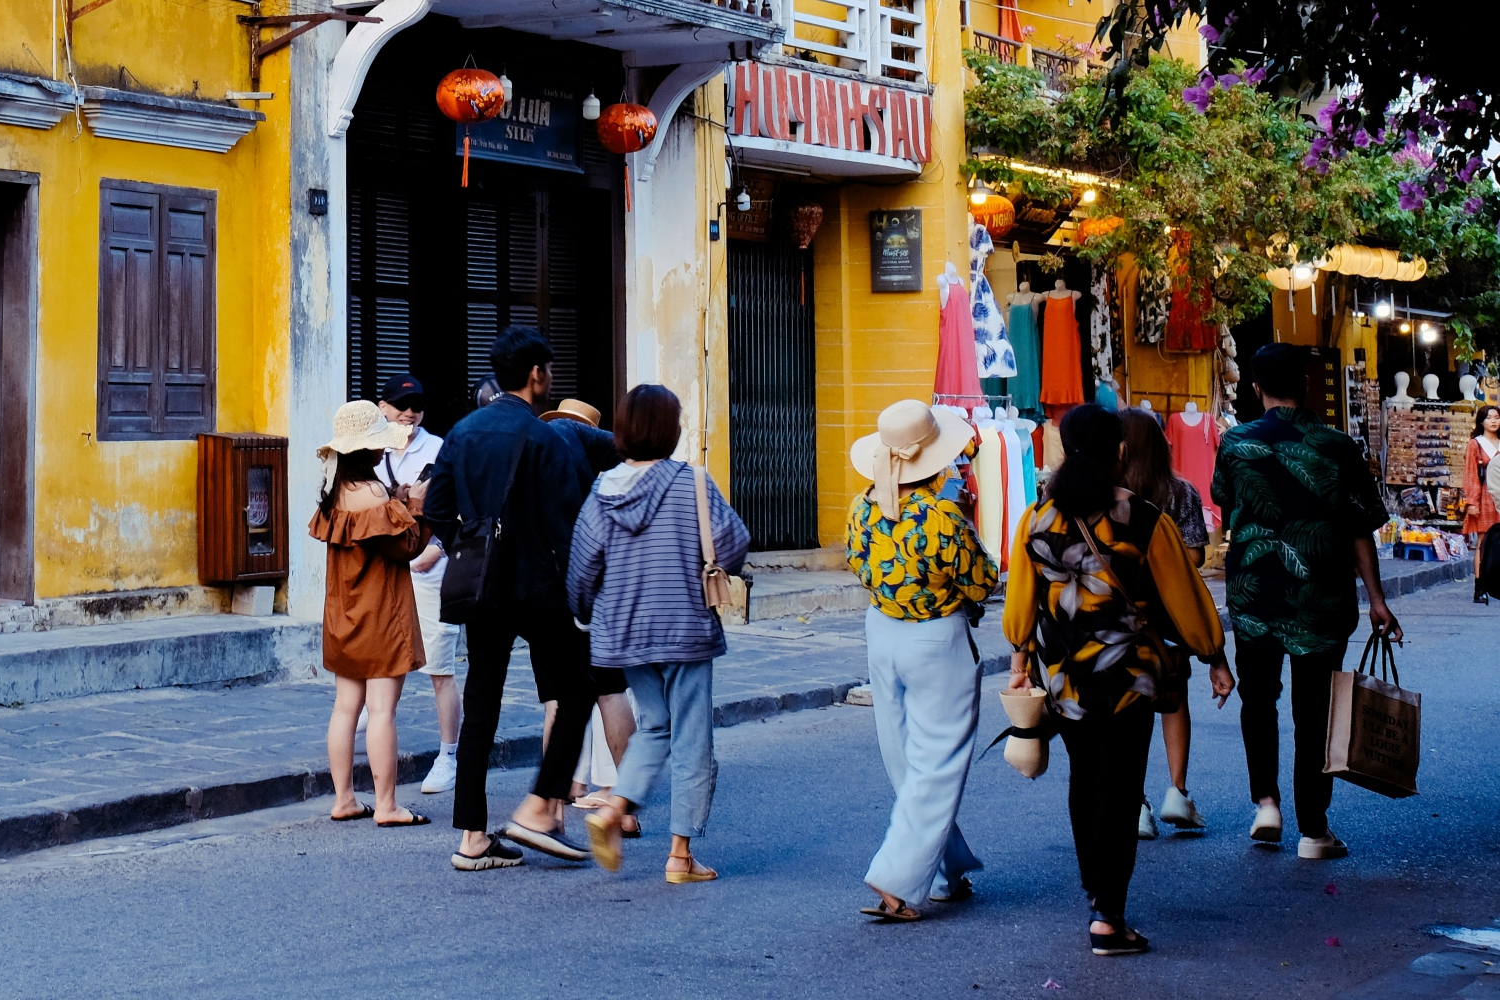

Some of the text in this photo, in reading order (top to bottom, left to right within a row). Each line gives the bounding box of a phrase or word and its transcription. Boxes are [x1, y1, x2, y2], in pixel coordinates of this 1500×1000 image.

[505, 125, 535, 143] SILK
[1362, 705, 1409, 731] SOMEDAY
[1370, 736, 1400, 755] LOUIS
[1385, 728, 1398, 741] BE
[1402, 735, 1408, 745] A
